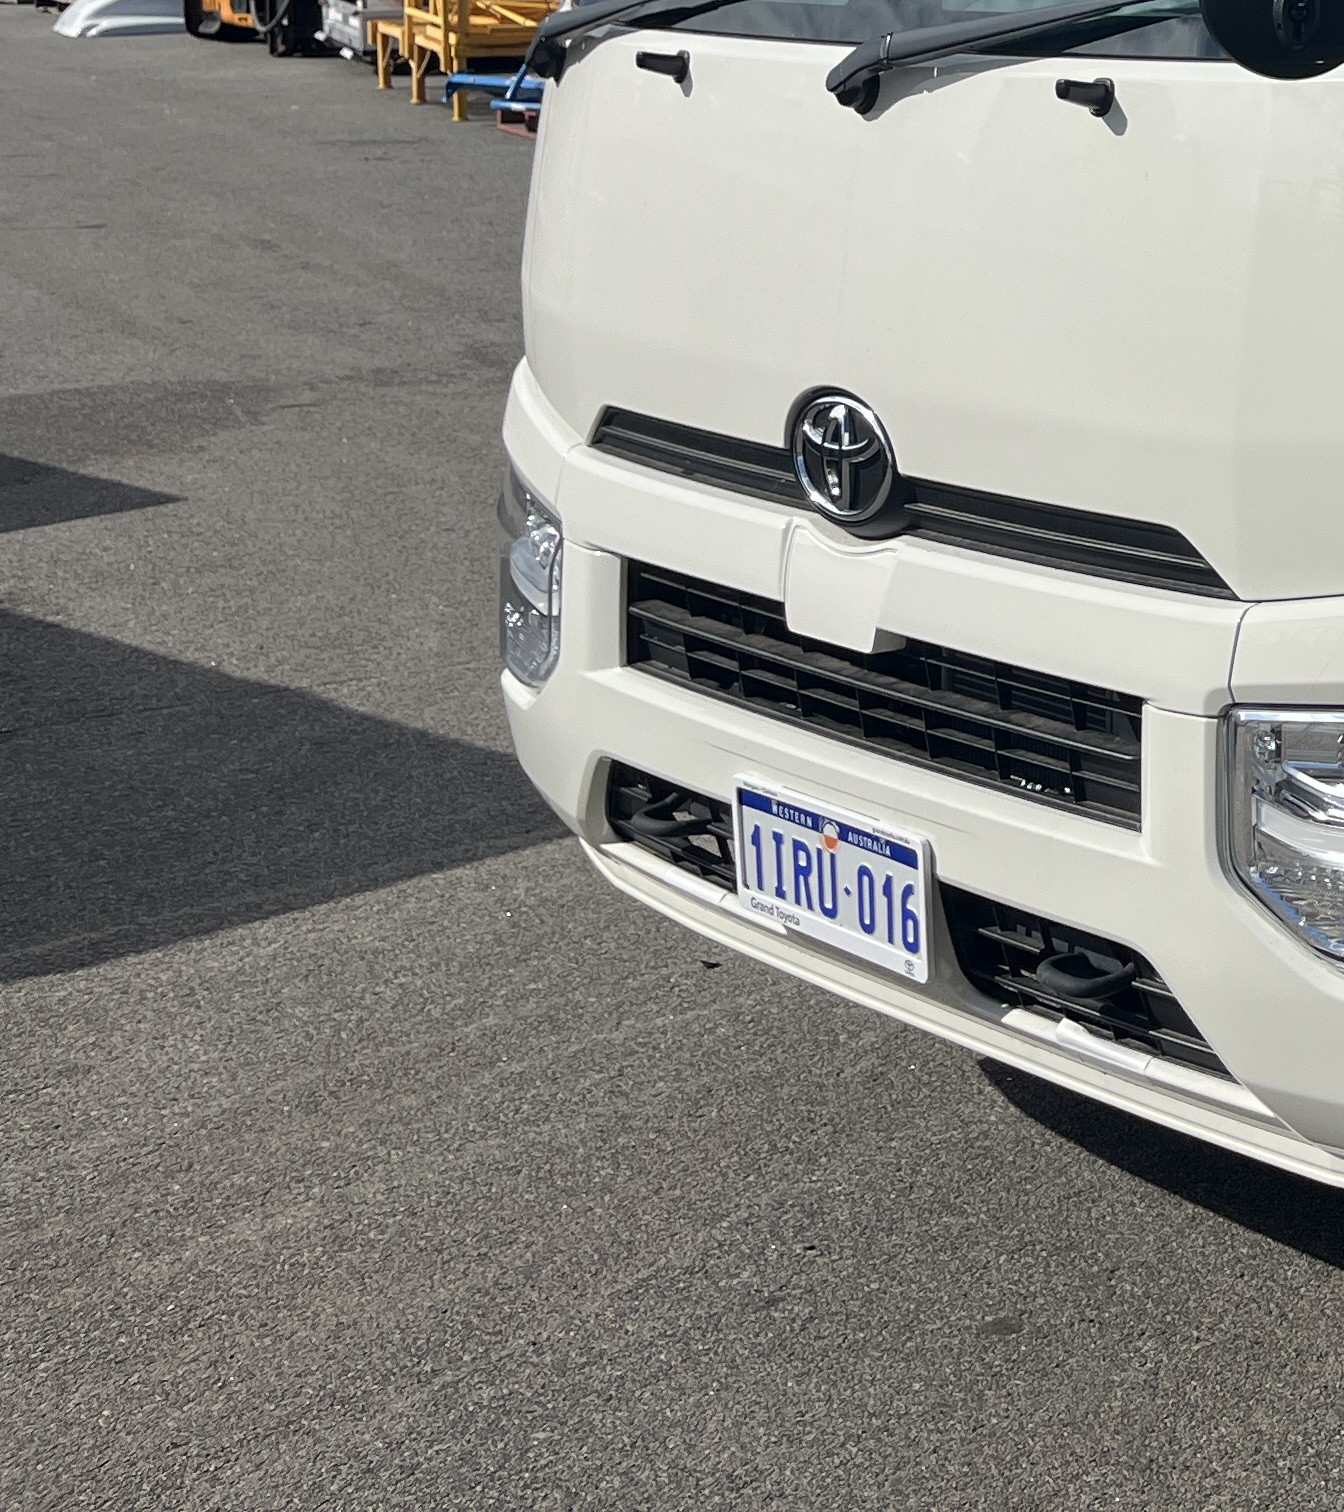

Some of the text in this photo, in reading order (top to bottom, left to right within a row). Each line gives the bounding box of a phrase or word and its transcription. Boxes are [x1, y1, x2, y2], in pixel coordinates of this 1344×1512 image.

[771, 799, 813, 829] WESTERN
[847, 830, 892, 858] AUSTRALIA
[750, 896, 800, 926] Grand Toyota
